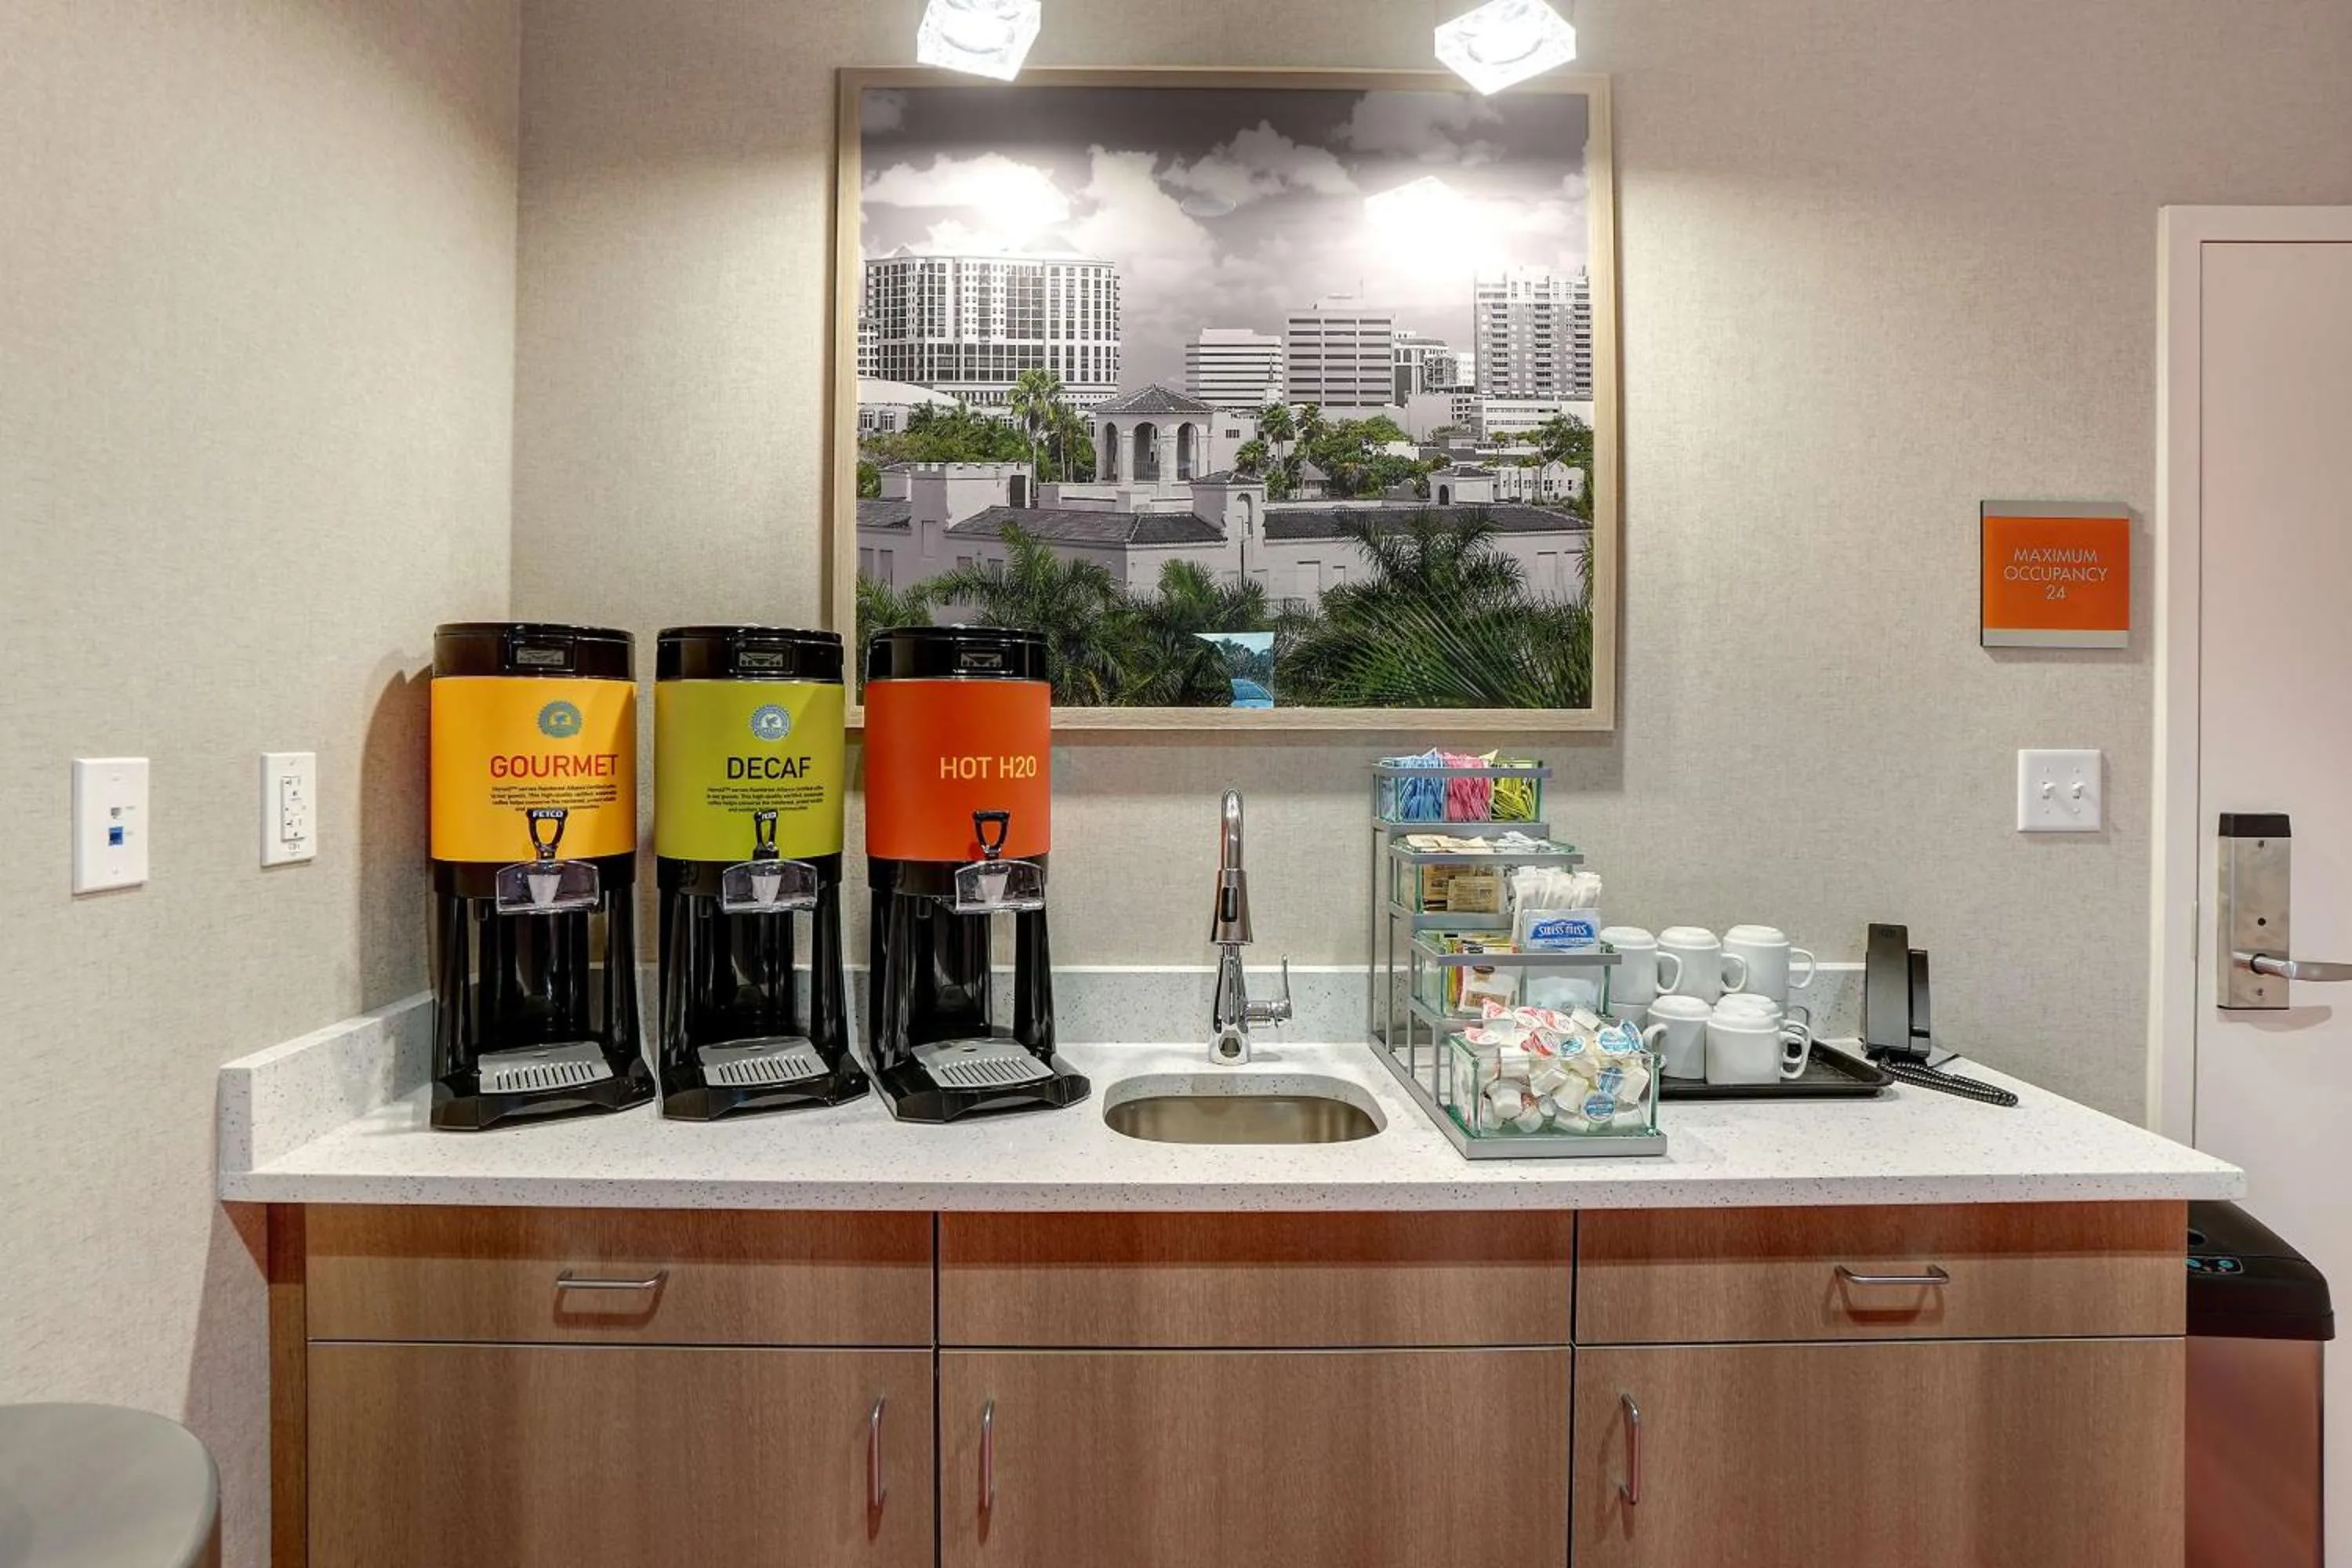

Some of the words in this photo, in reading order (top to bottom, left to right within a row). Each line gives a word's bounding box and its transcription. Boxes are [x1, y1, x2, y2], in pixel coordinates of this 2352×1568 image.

[2014, 549, 2097, 563] MAXIMUM
[2003, 565, 2107, 582] OCCUPANCY
[2045, 584, 2067, 600] 24
[490, 754, 619, 778] GOURMET
[727, 757, 811, 780] DECAF
[940, 757, 992, 779] HOT
